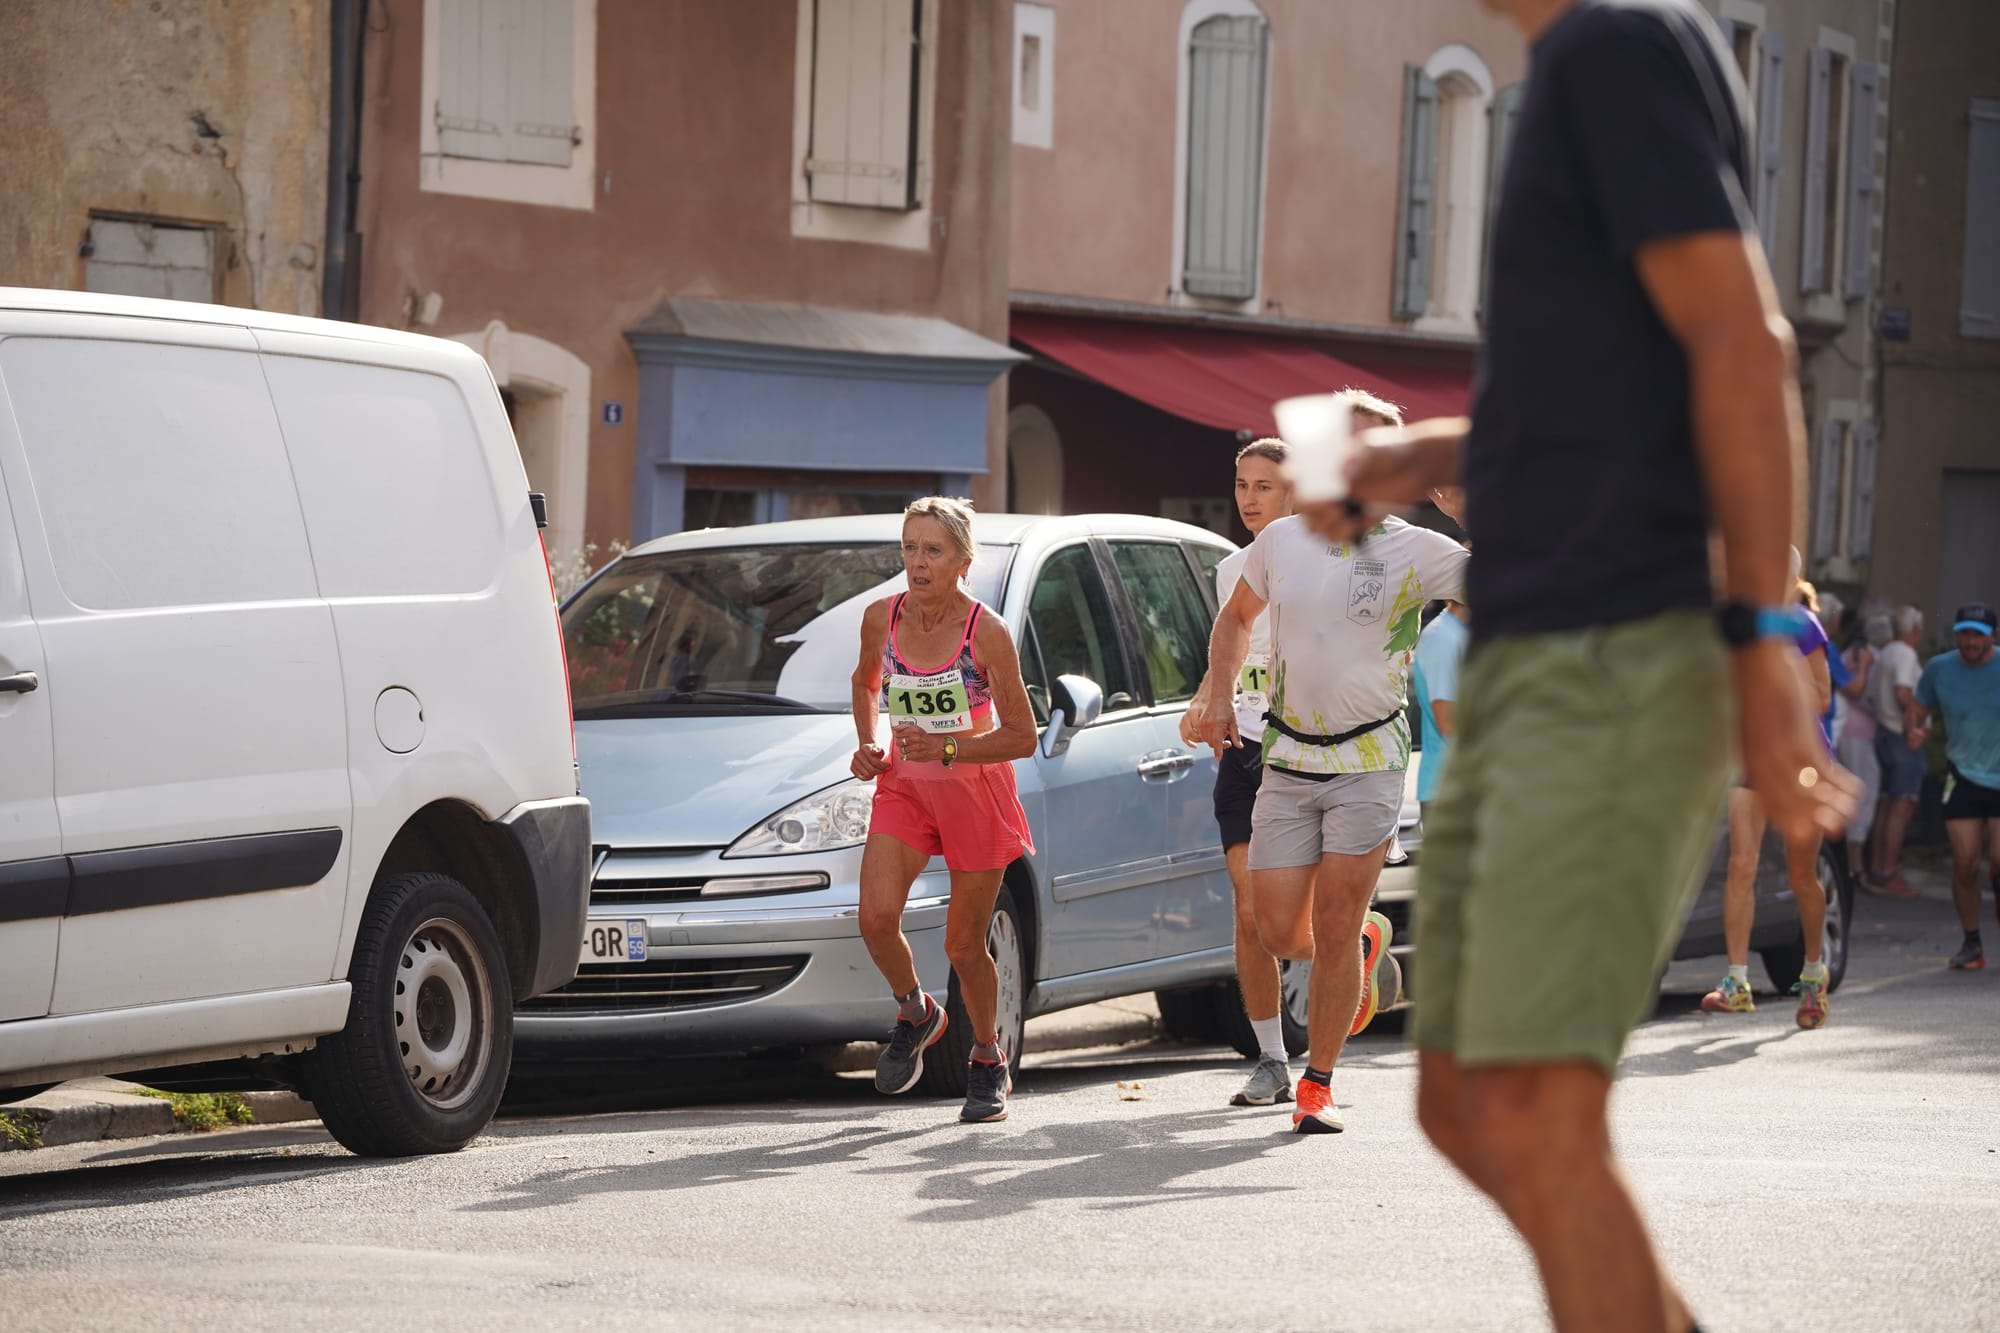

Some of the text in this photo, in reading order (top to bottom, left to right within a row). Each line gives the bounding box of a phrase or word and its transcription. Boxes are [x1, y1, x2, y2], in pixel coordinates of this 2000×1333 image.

[1249, 668, 1266, 690] 1
[899, 689, 956, 715] 136
[629, 940, 644, 955] 59
